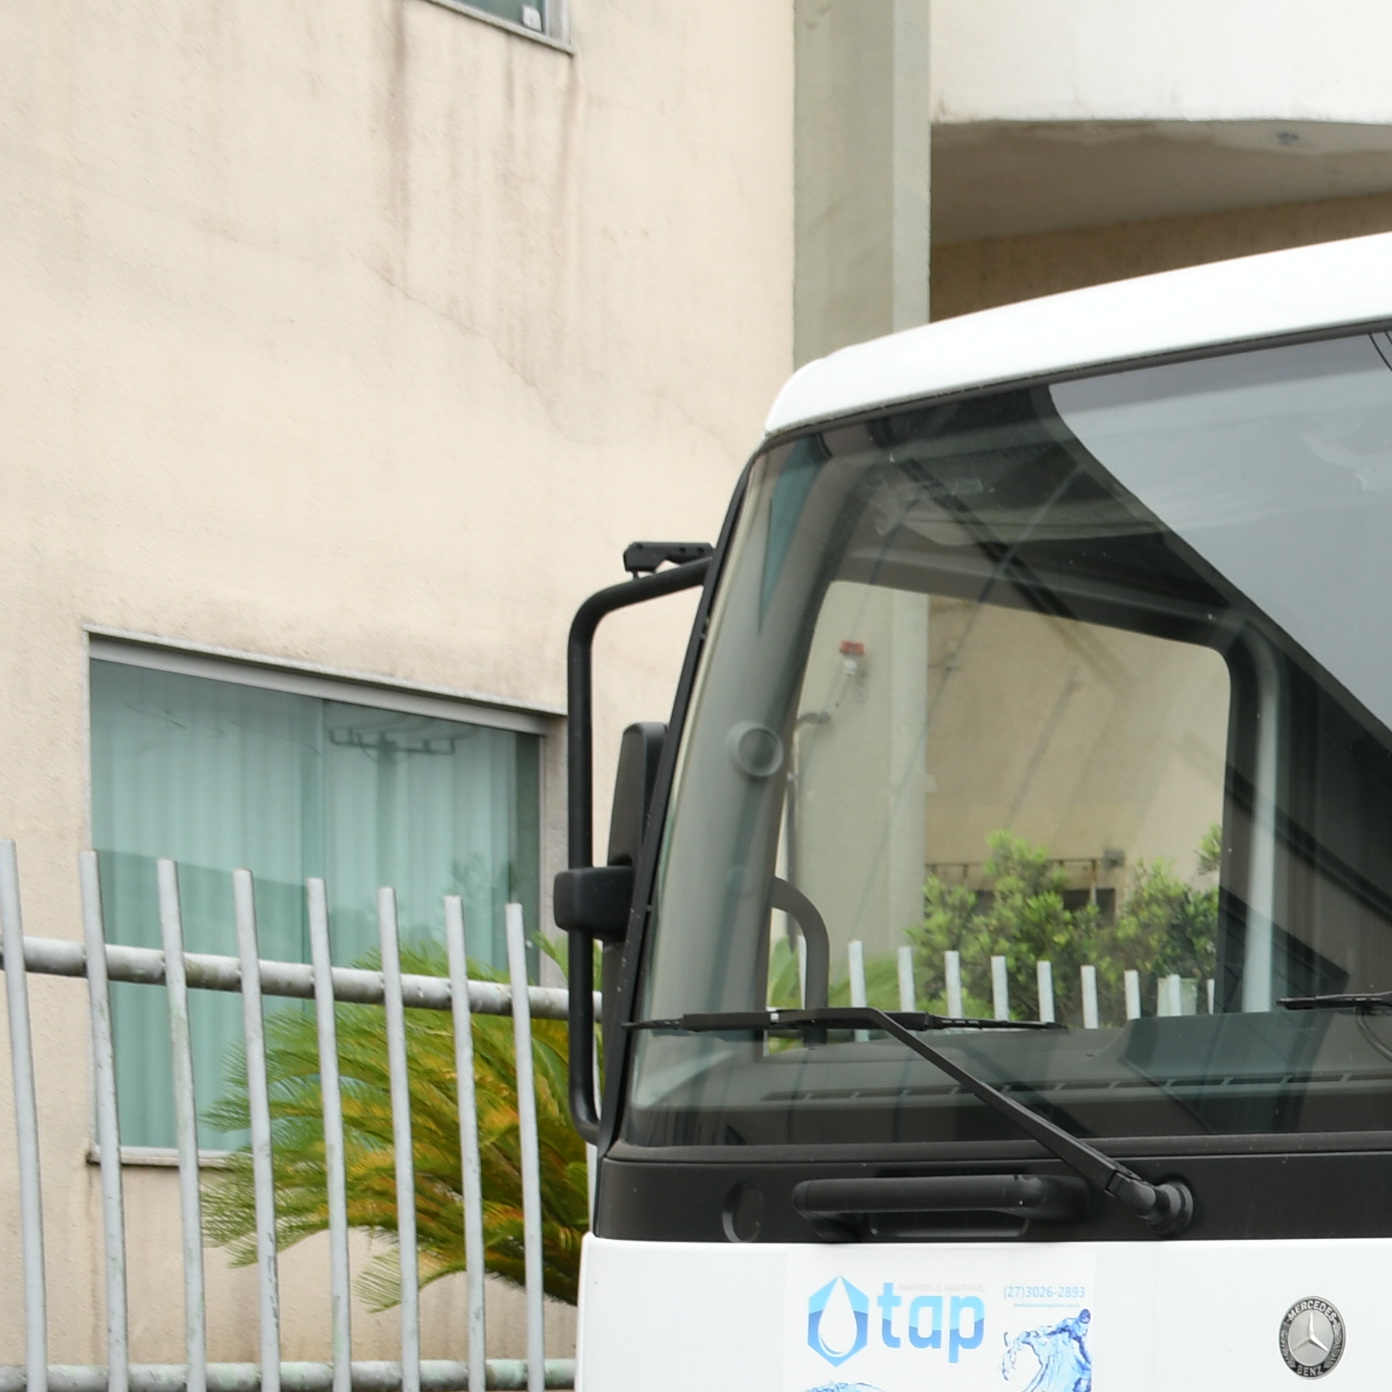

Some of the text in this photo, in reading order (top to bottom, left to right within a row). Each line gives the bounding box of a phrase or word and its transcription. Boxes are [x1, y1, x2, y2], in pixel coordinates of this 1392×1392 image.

[1003, 1286, 1086, 1299] (27)3026-2893
[1288, 1300, 1337, 1321] MERCEDES
[877, 1282, 985, 1363] tap
[1297, 1366, 1323, 1377] BENZ
